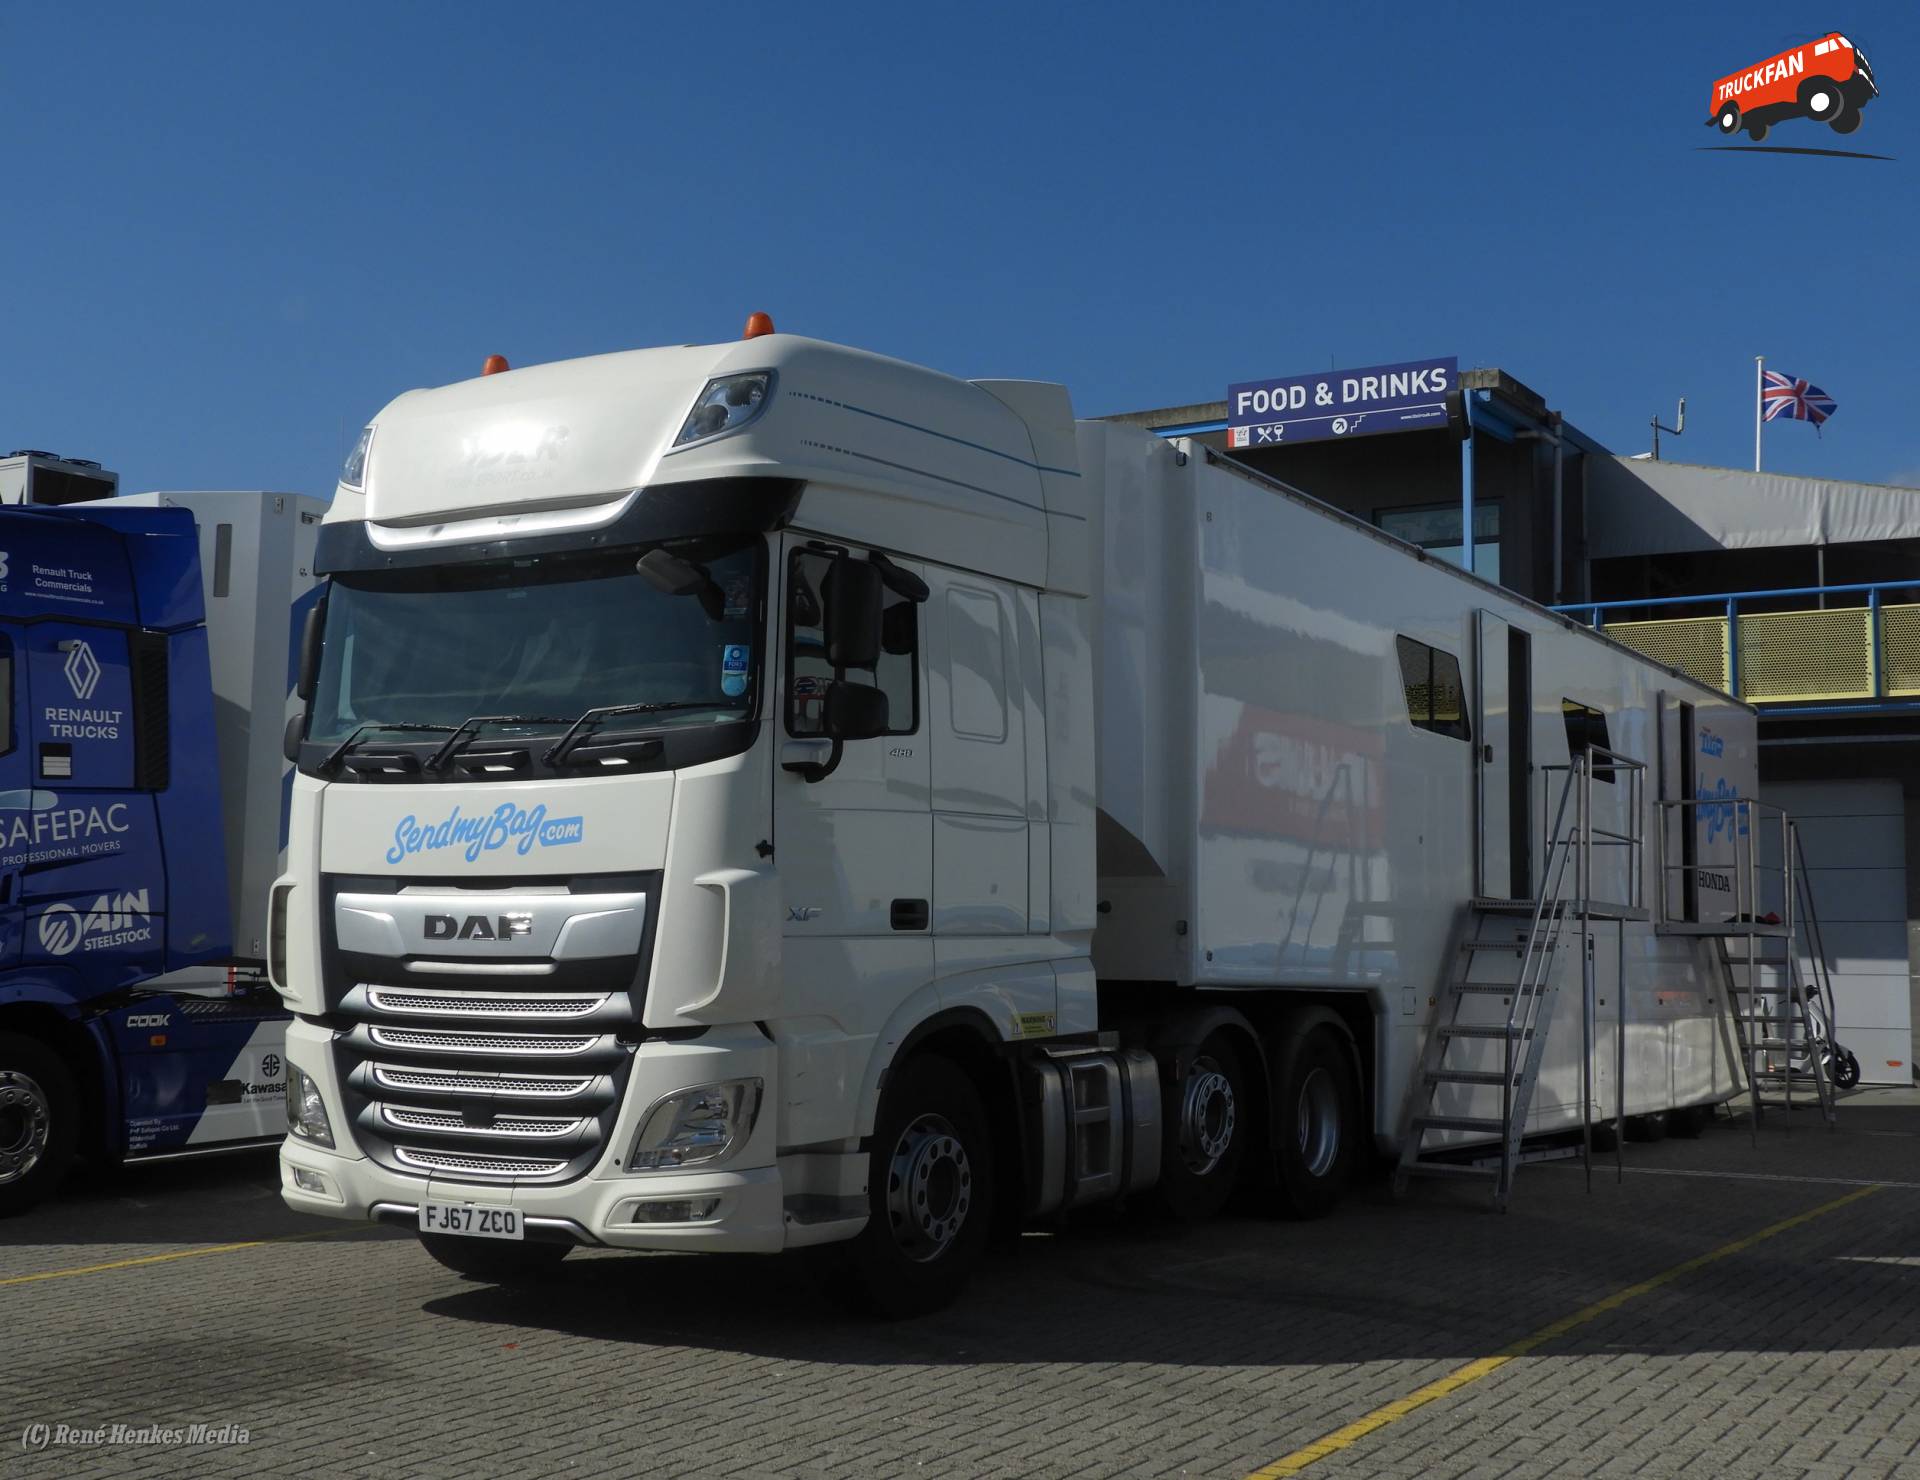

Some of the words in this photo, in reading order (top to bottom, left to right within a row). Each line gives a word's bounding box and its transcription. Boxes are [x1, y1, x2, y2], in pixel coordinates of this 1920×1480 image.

[1237, 385, 1306, 415] FOOD
[1314, 382, 1334, 406] &
[1343, 368, 1447, 403] DRINKS
[32, 564, 66, 578] Renault
[68, 569, 93, 581] Truck
[34, 578, 93, 593] Commercials
[45, 707, 122, 724] RENAULT
[49, 724, 118, 739] TRUCKS
[2, 848, 78, 866] PROFESSIONAL
[82, 840, 121, 854] MOVERS
[1698, 871, 1731, 892] HONDA
[786, 905, 823, 921] XF
[423, 912, 533, 941] DAF
[84, 927, 151, 951] STEELSTOCK
[127, 1014, 171, 1028] COOK
[426, 1206, 473, 1231] FJ67
[478, 1210, 516, 1234] ZCO
